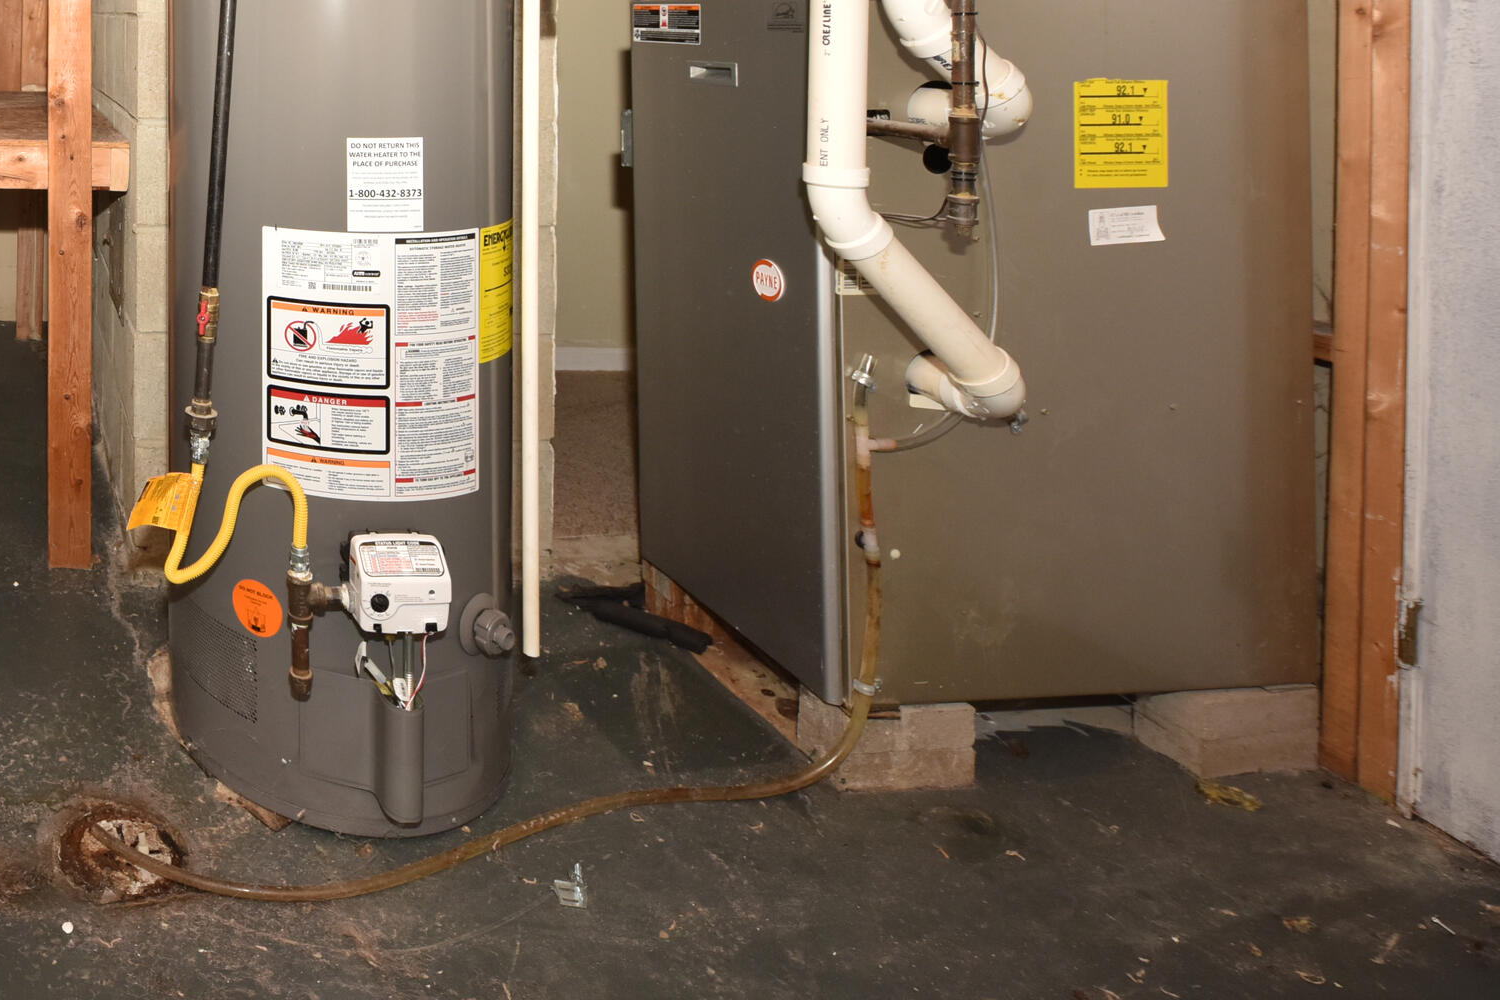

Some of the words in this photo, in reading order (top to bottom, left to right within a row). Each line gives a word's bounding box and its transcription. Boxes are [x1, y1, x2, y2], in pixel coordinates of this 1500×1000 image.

[1116, 84, 1136, 97] 92.1
[1111, 113, 1131, 125] 91.0
[819, 117, 829, 143] ONLY
[1114, 141, 1133, 153] 92.1
[819, 149, 829, 168] ENT
[348, 188, 422, 198] 1-800-432-8373
[755, 271, 778, 290] PAYNE
[312, 307, 355, 316] WARNING
[312, 396, 348, 406] DANGER
[319, 458, 345, 466] WARNING
